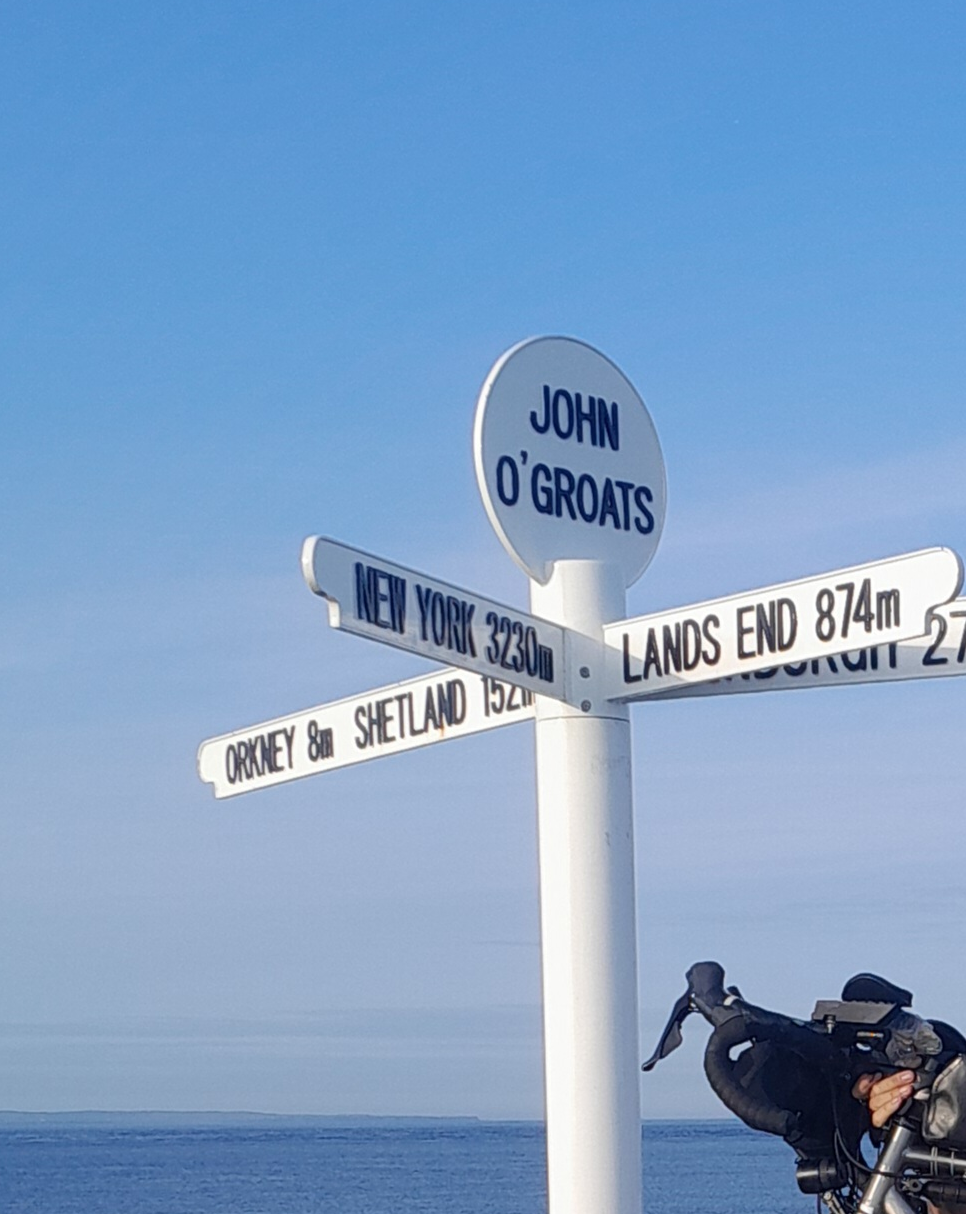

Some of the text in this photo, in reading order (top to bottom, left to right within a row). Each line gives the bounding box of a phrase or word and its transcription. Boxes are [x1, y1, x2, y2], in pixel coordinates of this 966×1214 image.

[530, 384, 619, 451] JOHN
[496, 450, 655, 535] O'GROATS
[353, 561, 554, 684] NEW YORK 3230m
[623, 613, 721, 684] LANDS
[736, 596, 798, 660] END
[815, 578, 901, 642] 874m
[225, 725, 295, 785] ORKNEY
[307, 720, 334, 762] 8m
[354, 678, 466, 749] SHETLAND
